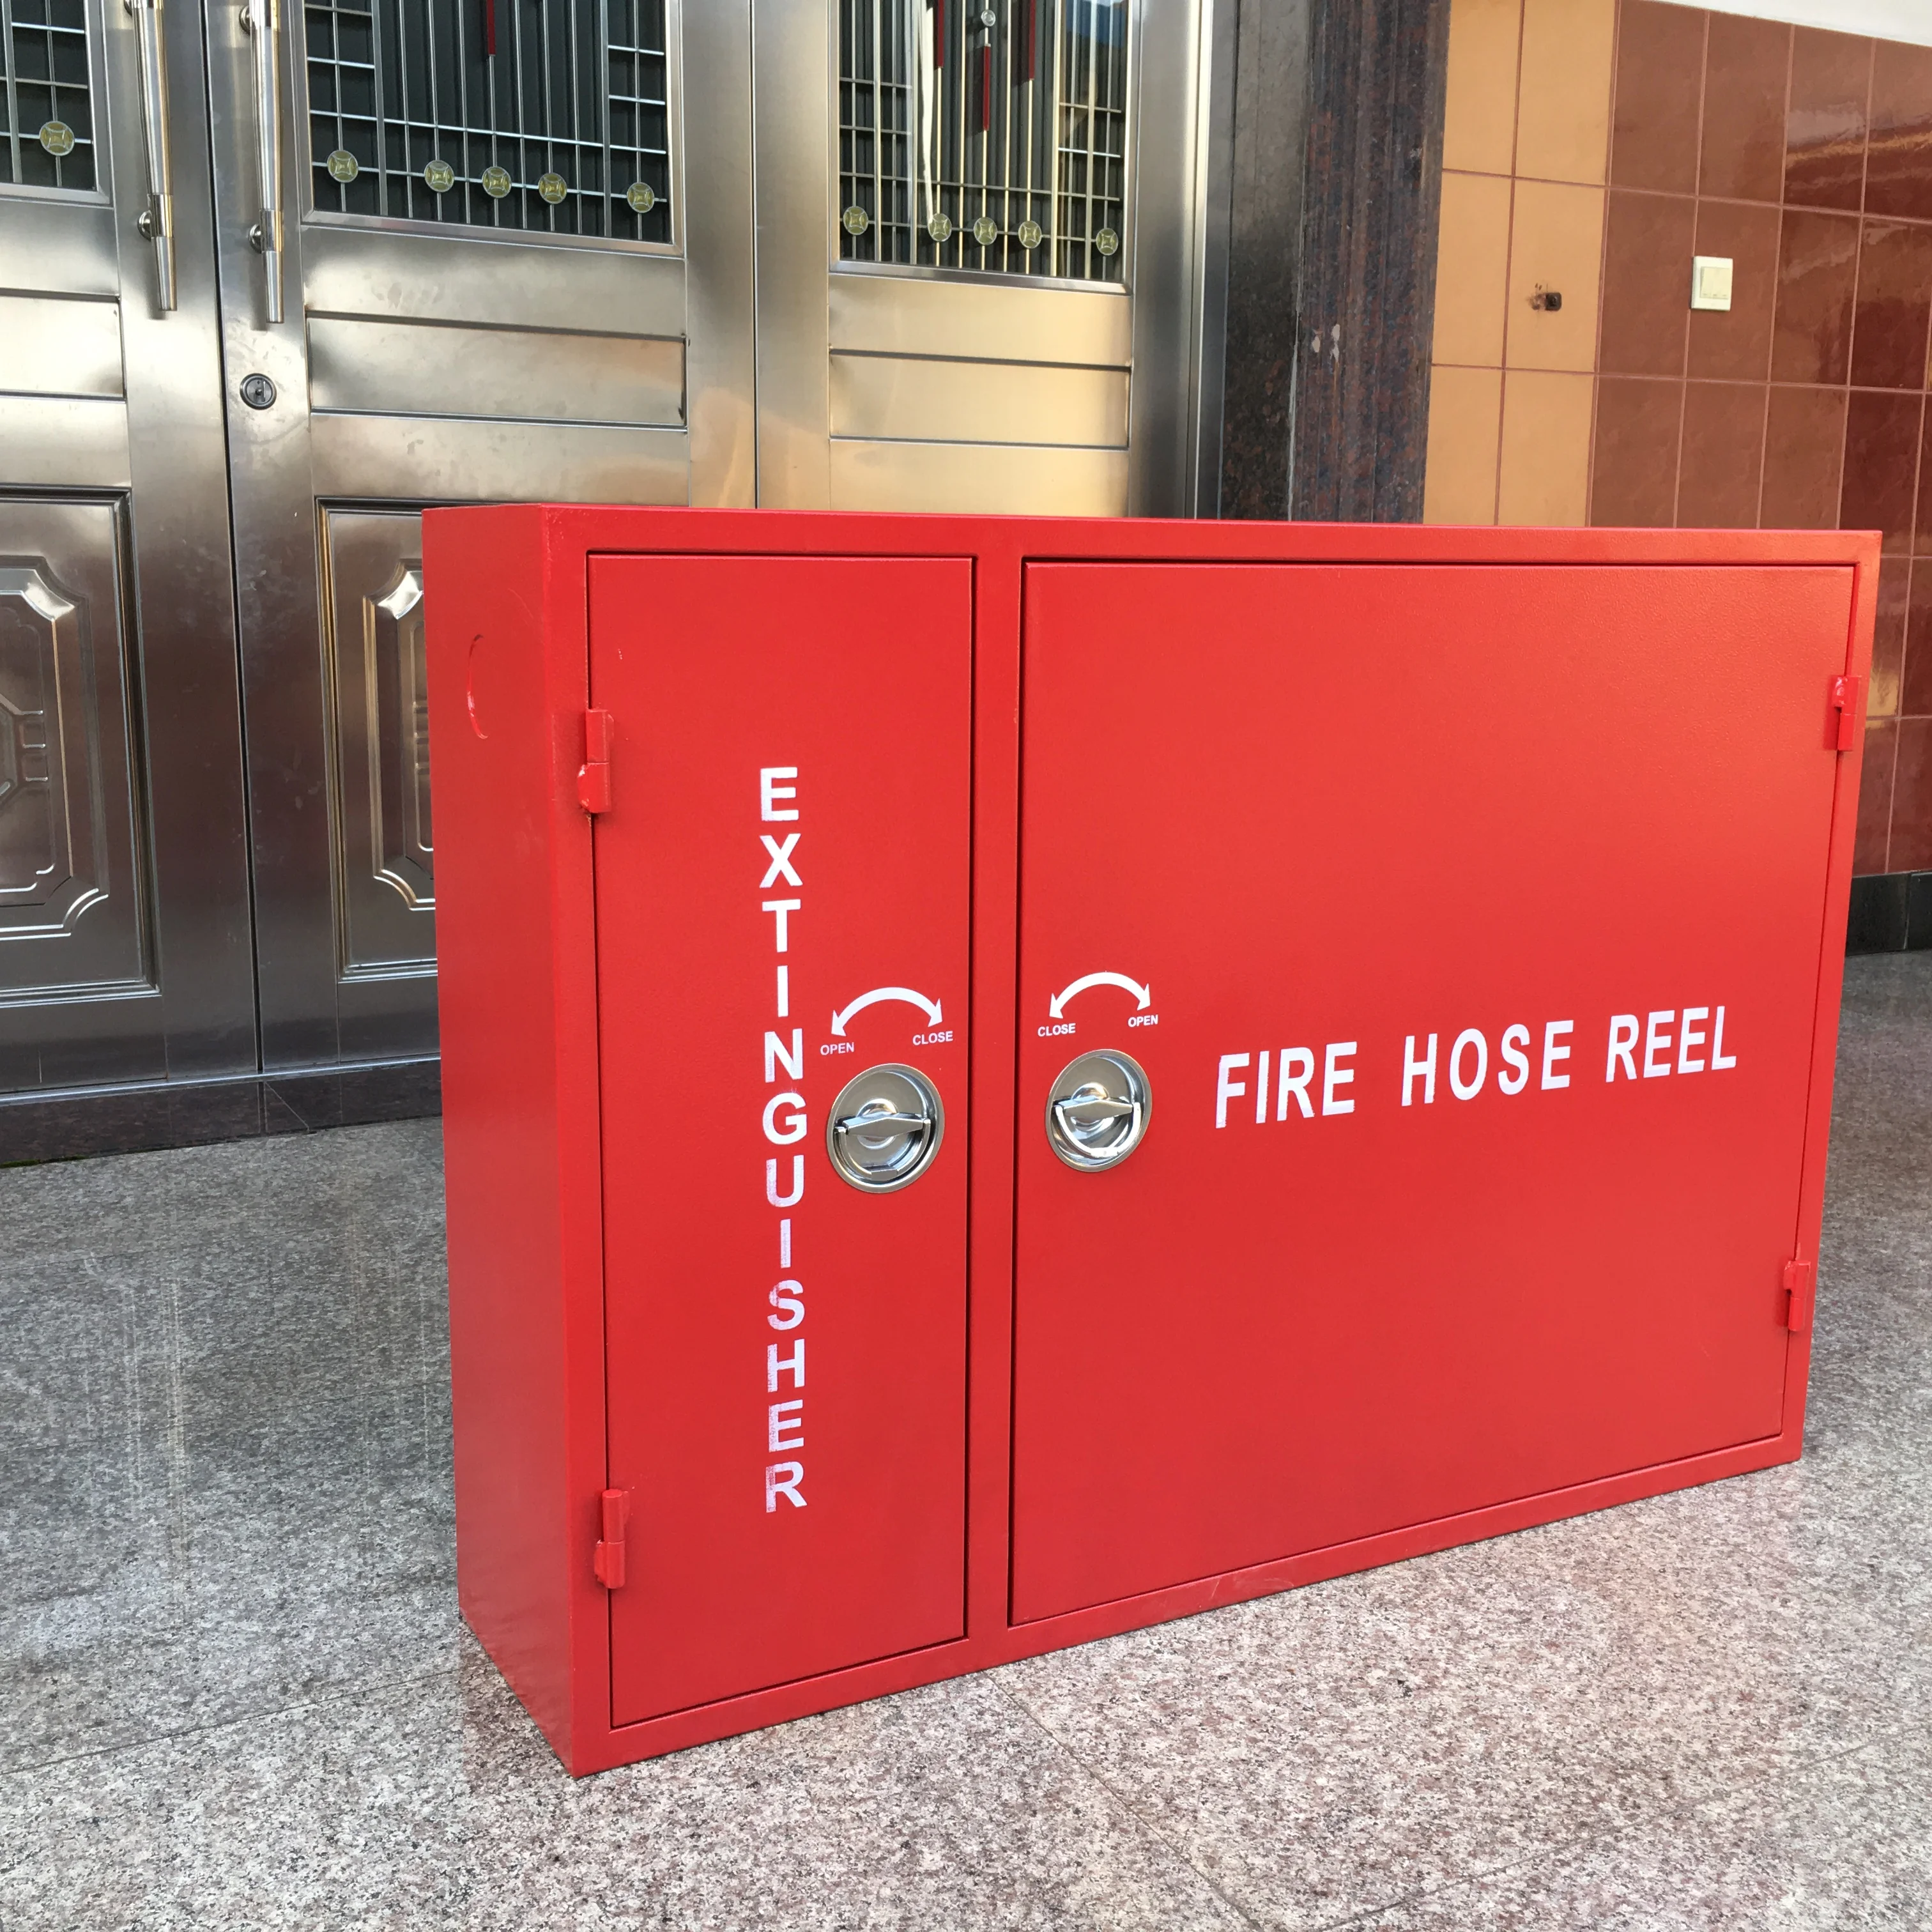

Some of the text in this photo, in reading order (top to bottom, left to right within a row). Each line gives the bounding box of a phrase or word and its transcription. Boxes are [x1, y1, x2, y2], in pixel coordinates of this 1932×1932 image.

[1128, 1014, 1159, 1028] OPEN
[912, 1030, 954, 1046] CLOSE
[1038, 1022, 1077, 1038] CLOSE
[820, 1041, 855, 1056] OPEN
[1215, 1005, 1737, 1129] FIRE HOSE REEL
[759, 766, 808, 1513] EXTINGUISHER
